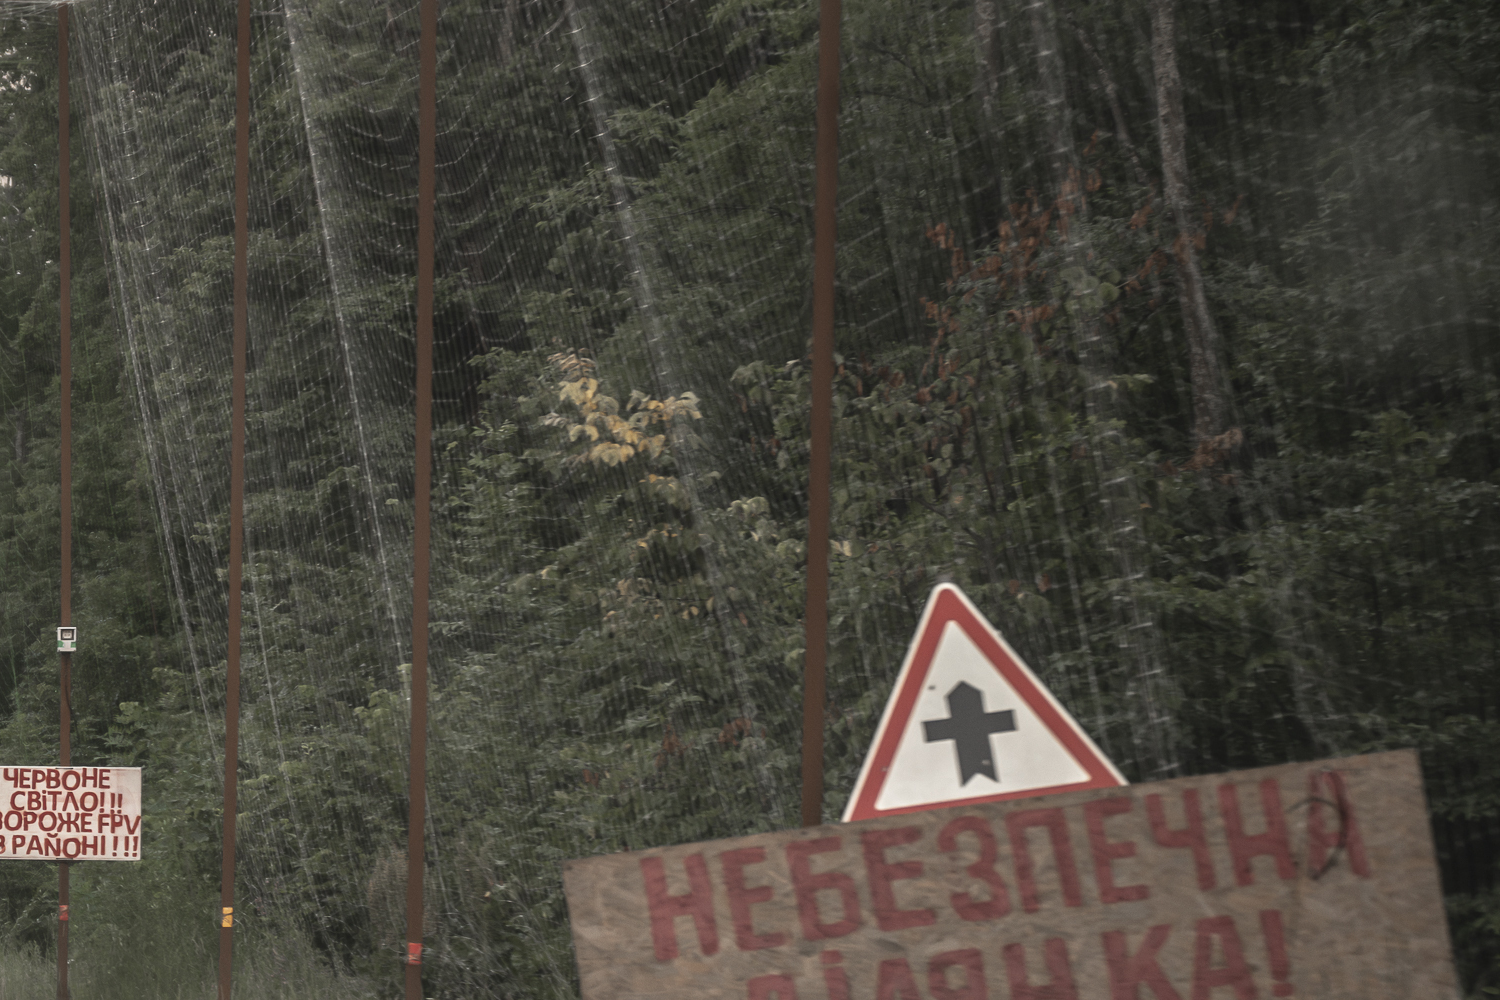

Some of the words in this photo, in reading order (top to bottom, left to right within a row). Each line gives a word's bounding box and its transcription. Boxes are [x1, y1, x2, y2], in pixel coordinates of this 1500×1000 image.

[3, 767, 111, 790] ЧЕРВОНЕ
[98, 813, 142, 835] FPV
[639, 769, 1371, 964] НЕБЕЗПЕЧНА
